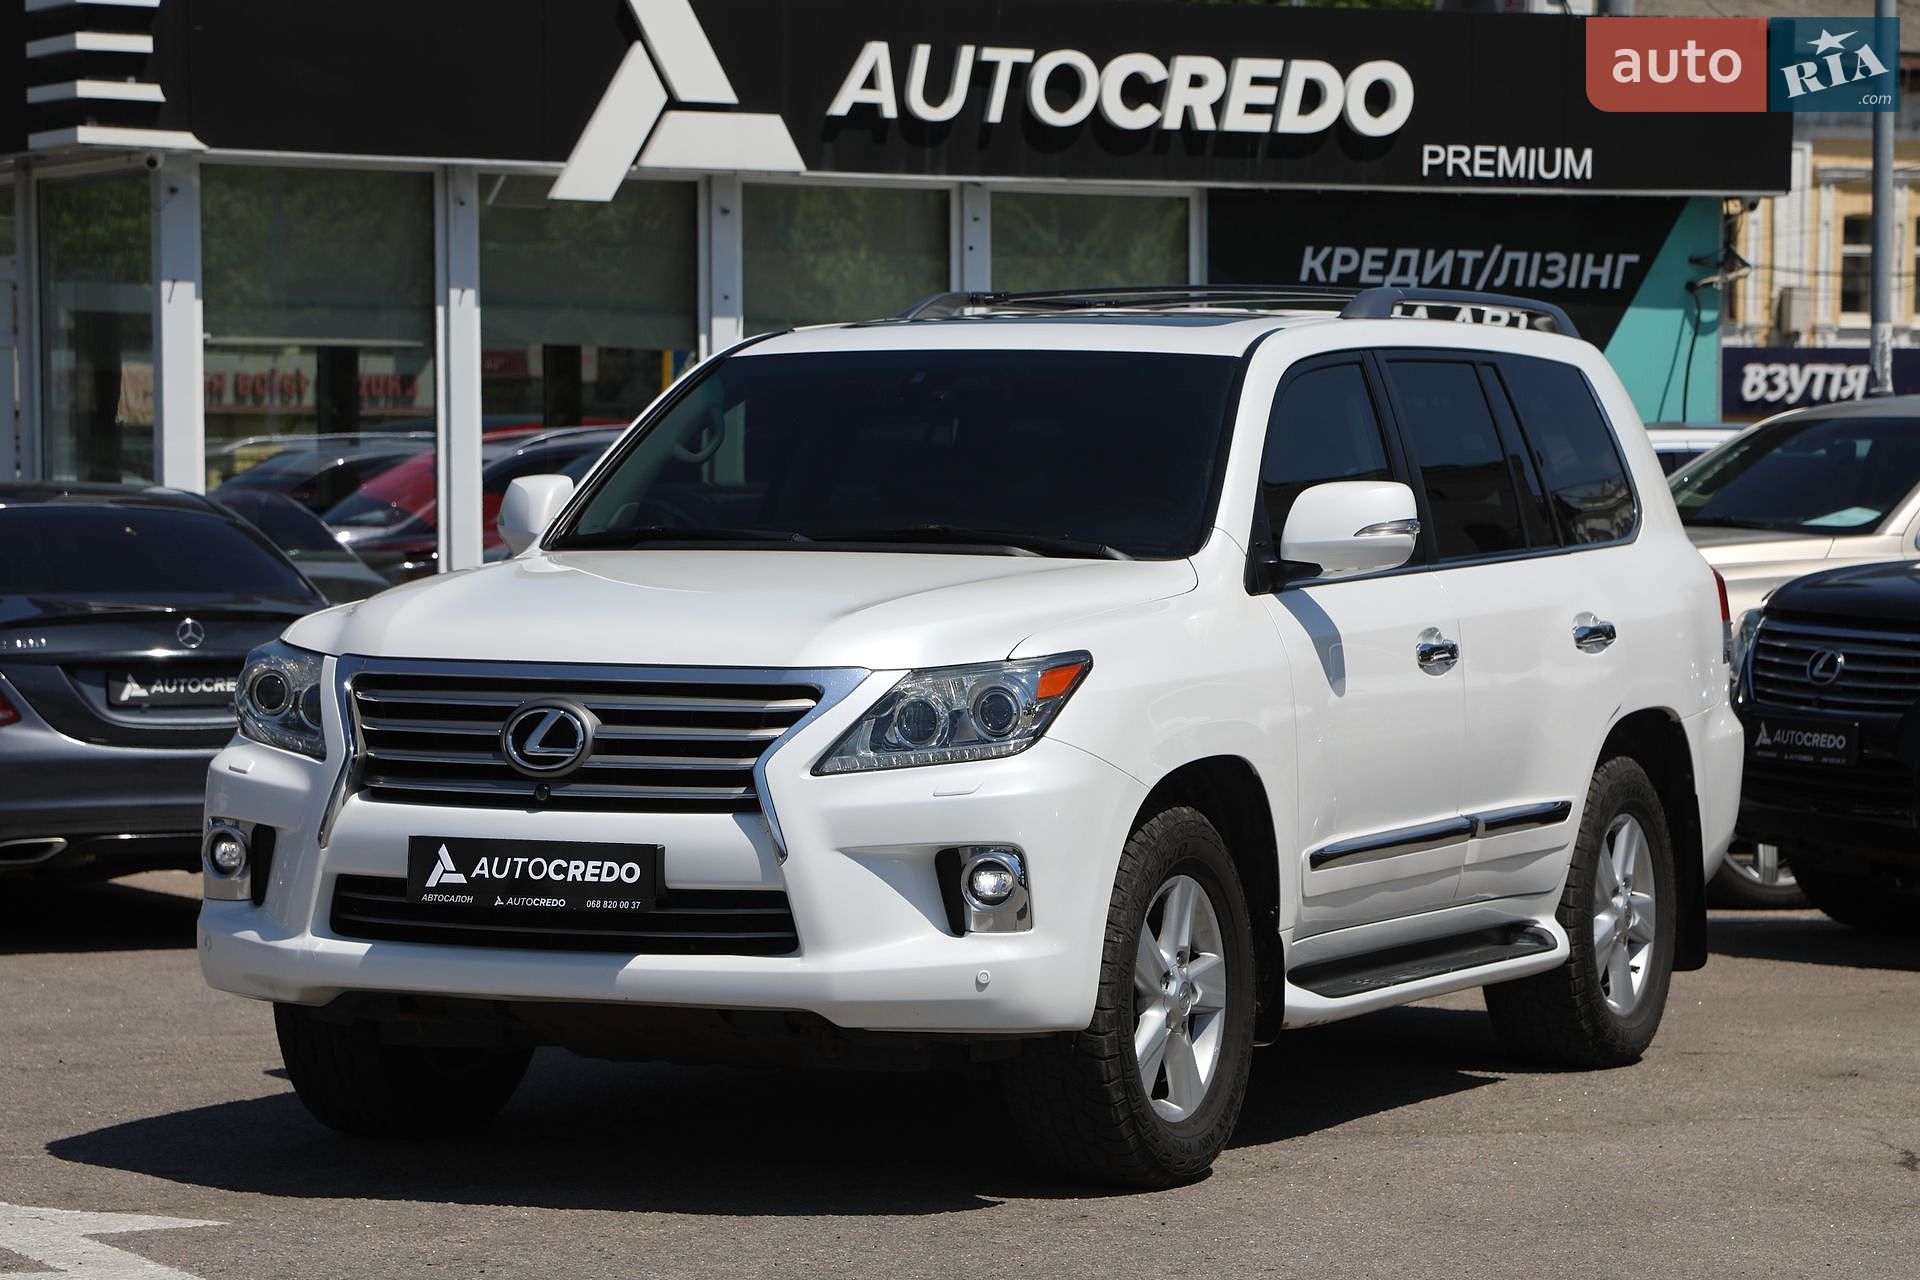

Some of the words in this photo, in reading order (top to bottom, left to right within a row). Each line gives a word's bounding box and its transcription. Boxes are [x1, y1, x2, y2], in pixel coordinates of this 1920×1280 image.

[826, 40, 1414, 138] AUTOCREDO
[1422, 144, 1593, 180] PREMIUM
[1299, 244, 1641, 291] КРЕДИТ/ЛІЗІНГ
[1741, 363, 1871, 404] ВЗУТТЯ
[151, 678, 239, 693] AUTOCRE
[1773, 729, 1847, 750] AUTOCREDO
[470, 856, 642, 884] AUTOCREDO
[421, 893, 474, 904] АВТОСАЛОН
[506, 897, 566, 908] AUTOCREDO
[586, 899, 601, 909] 068
[602, 900, 618, 909] 820
[619, 900, 630, 909] 00
[630, 901, 641, 909] 37
